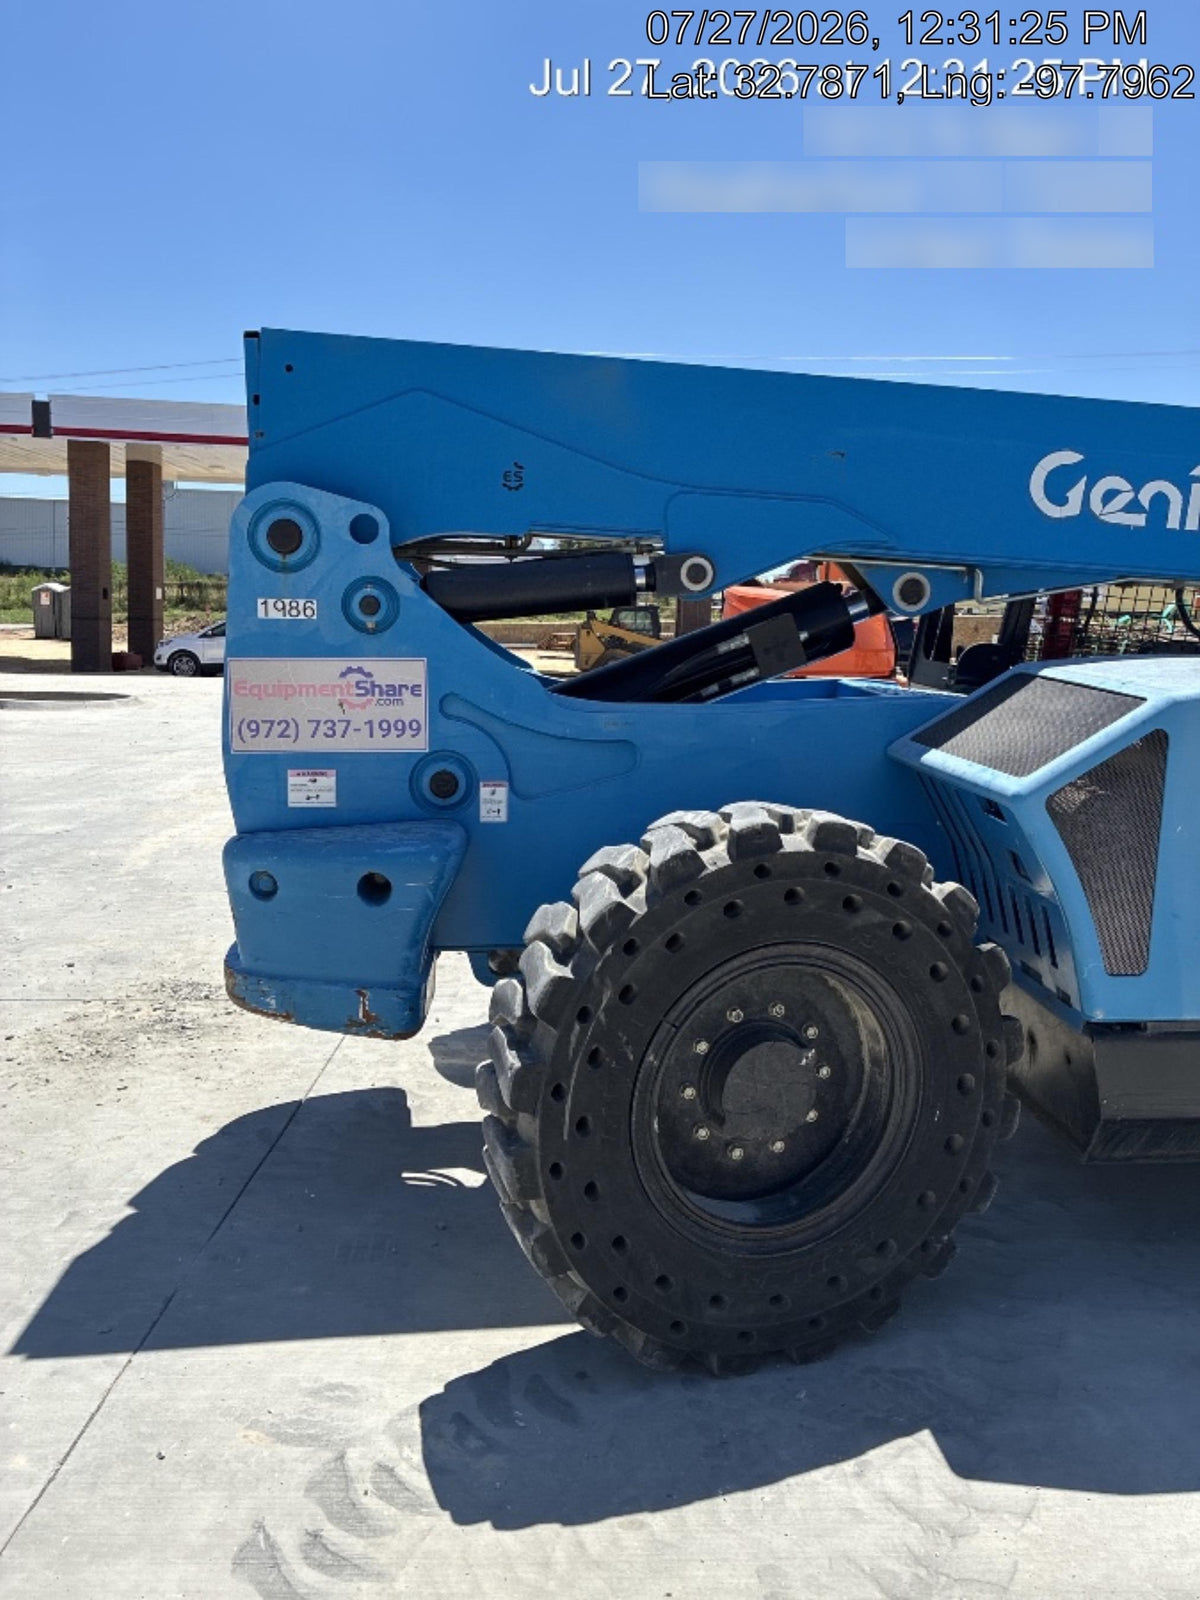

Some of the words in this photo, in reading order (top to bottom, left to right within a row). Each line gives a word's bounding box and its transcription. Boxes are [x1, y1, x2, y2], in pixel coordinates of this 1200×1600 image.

[259, 599, 316, 618] 1986
[233, 680, 422, 701] EquipmentShare
[374, 698, 404, 706] .com
[237, 717, 300, 743] (972)
[307, 718, 422, 739] 737-1999
